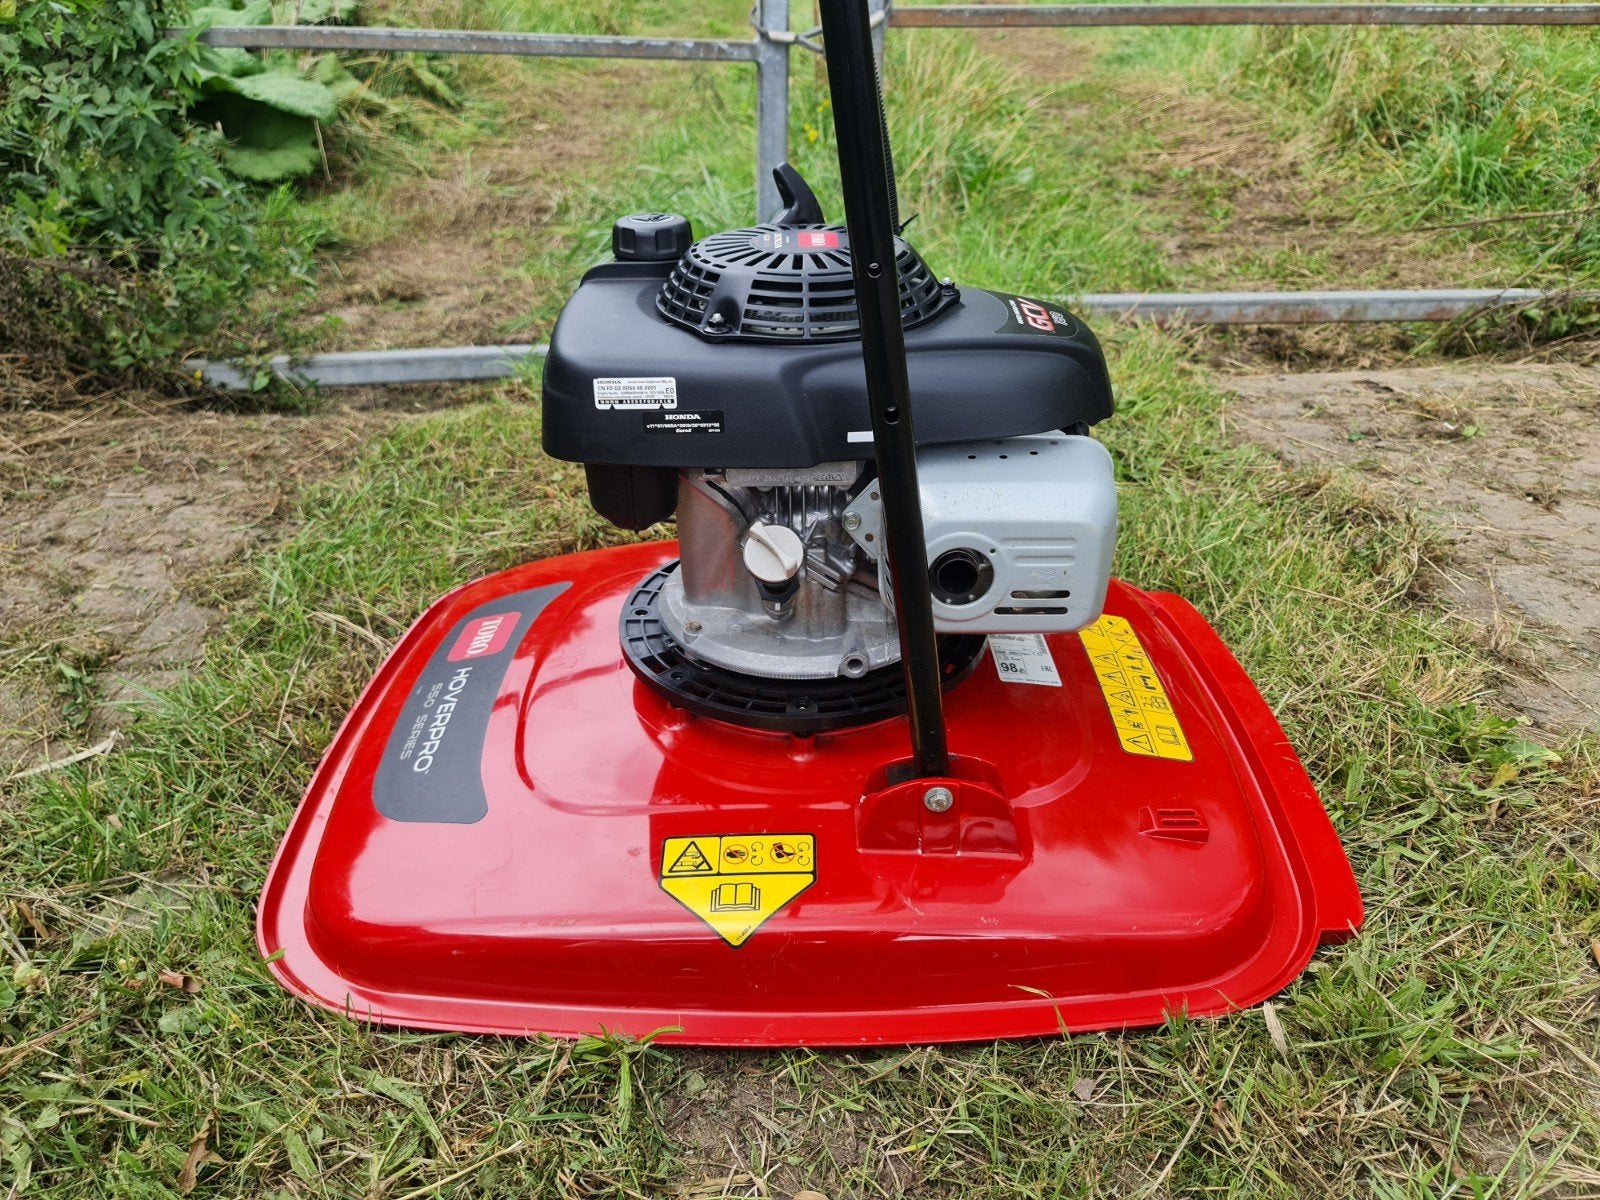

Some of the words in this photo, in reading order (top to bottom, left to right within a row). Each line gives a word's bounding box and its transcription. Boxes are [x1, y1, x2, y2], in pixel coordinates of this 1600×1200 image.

[1015, 297, 1055, 331] GCV
[664, 413, 702, 421] HONDA
[466, 616, 504, 655] TORO
[1000, 662, 1018, 673] 98
[423, 682, 444, 708] 550
[412, 666, 474, 773] HOVERPRO
[399, 714, 428, 760] SERIES
